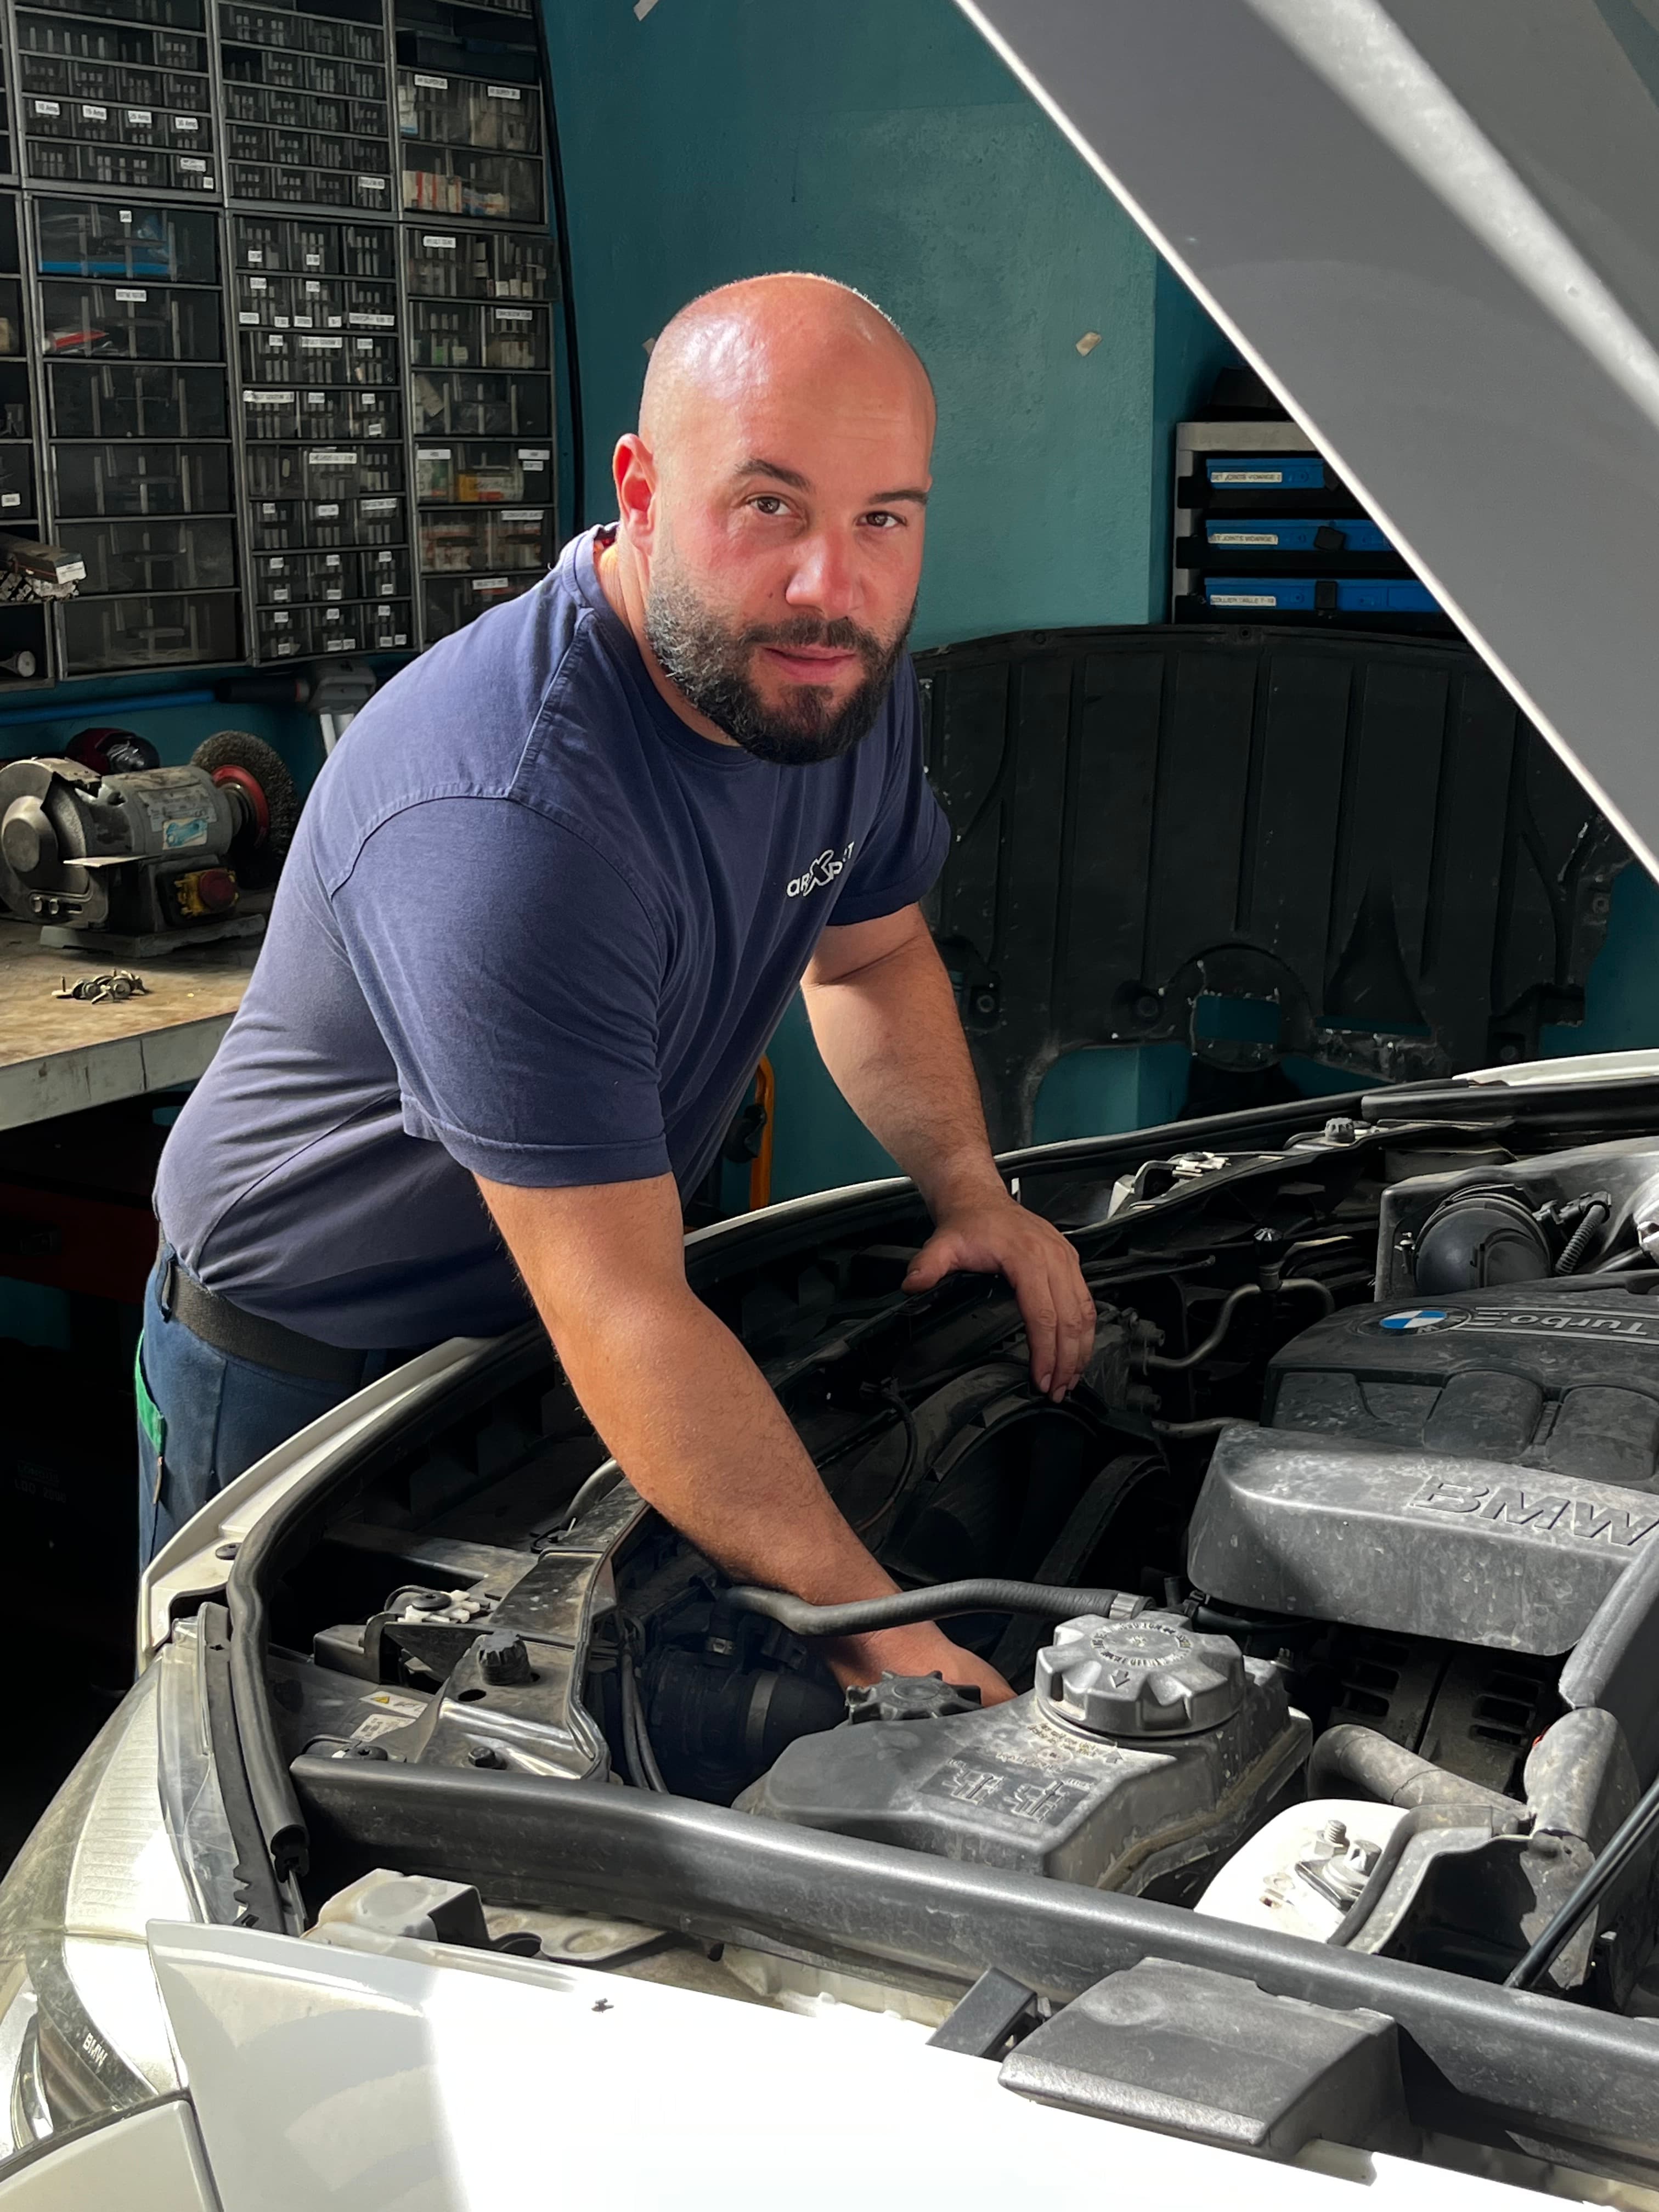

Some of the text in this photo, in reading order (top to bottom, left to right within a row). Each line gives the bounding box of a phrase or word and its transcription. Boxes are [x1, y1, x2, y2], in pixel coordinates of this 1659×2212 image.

[1510, 1314, 1647, 1336] Turbo
[1408, 1476, 1659, 1546] BMW
[83, 2032, 108, 2067] BMW
